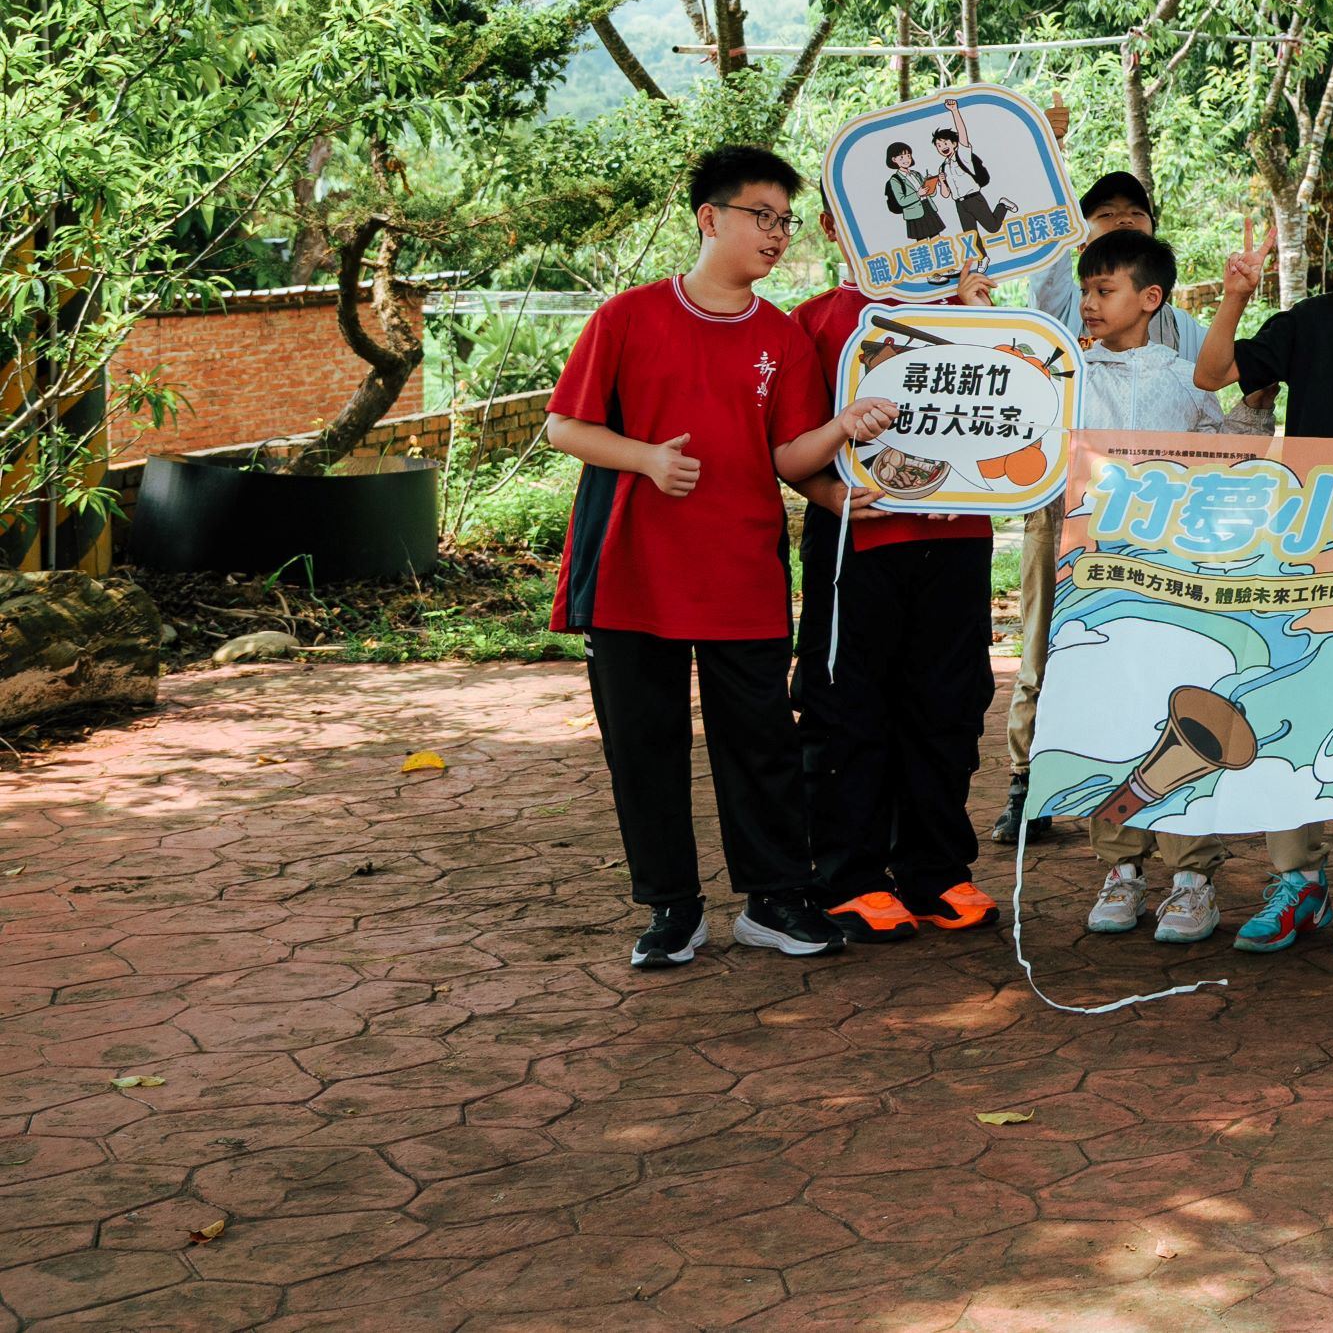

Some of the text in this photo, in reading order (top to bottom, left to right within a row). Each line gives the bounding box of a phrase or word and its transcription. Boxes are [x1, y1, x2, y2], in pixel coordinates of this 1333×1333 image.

[868, 241, 954, 286] 職人講座
[986, 209, 1073, 251] 一日探索
[903, 362, 1011, 396] 尋找新竹
